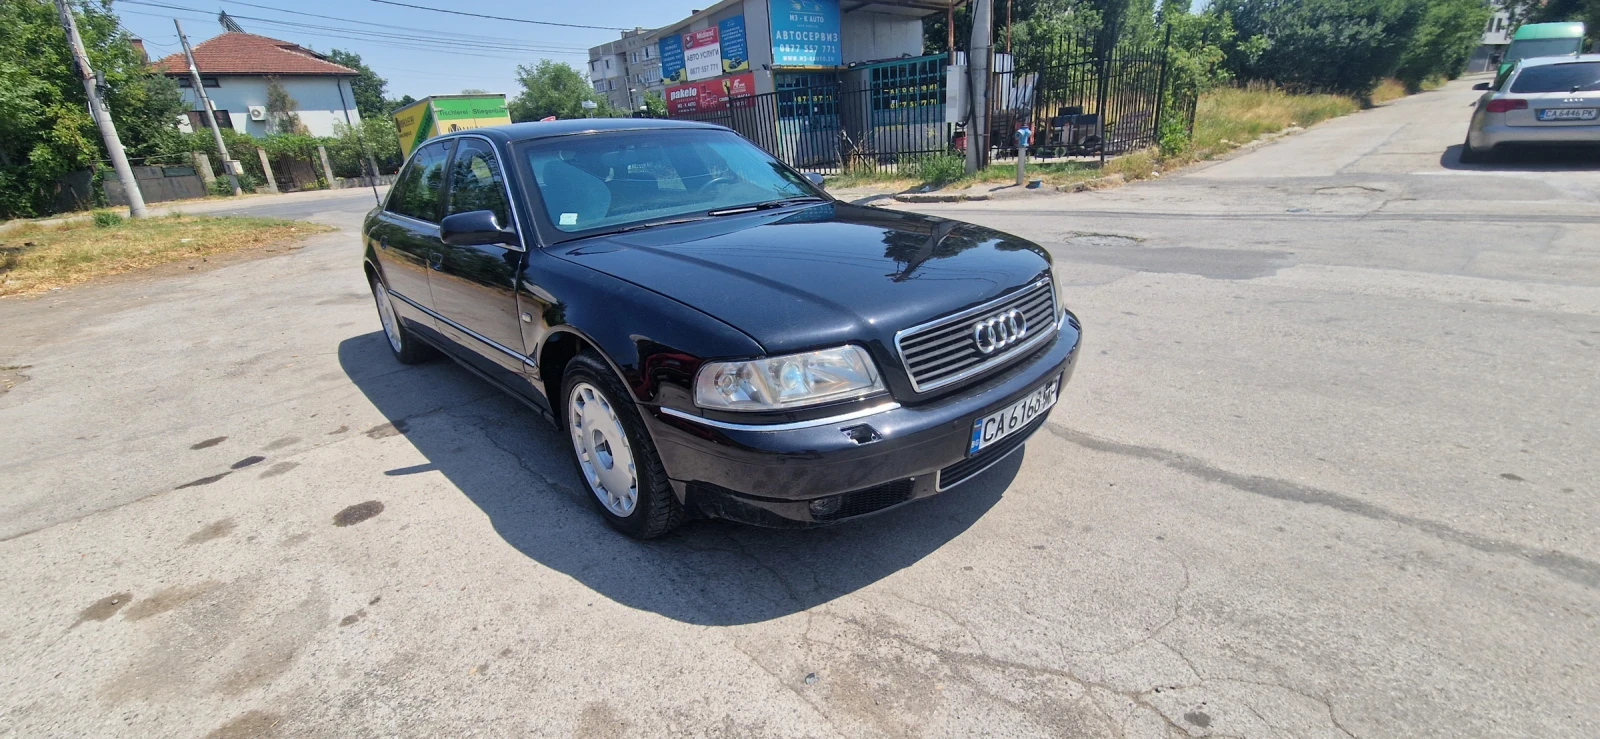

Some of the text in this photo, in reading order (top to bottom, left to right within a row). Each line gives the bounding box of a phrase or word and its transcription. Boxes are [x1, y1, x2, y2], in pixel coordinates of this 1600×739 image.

[696, 29, 714, 39] Midland
[776, 30, 838, 42] АВТОСЕРВИЗ
[780, 44, 836, 53] 0877 557 771
[686, 53, 699, 62] АВТО
[700, 48, 720, 59] УСЛУГИ
[690, 66, 700, 74] 0877
[702, 65, 710, 73] 557
[670, 88, 697, 100] pakelo
[983, 413, 1004, 443] CA
